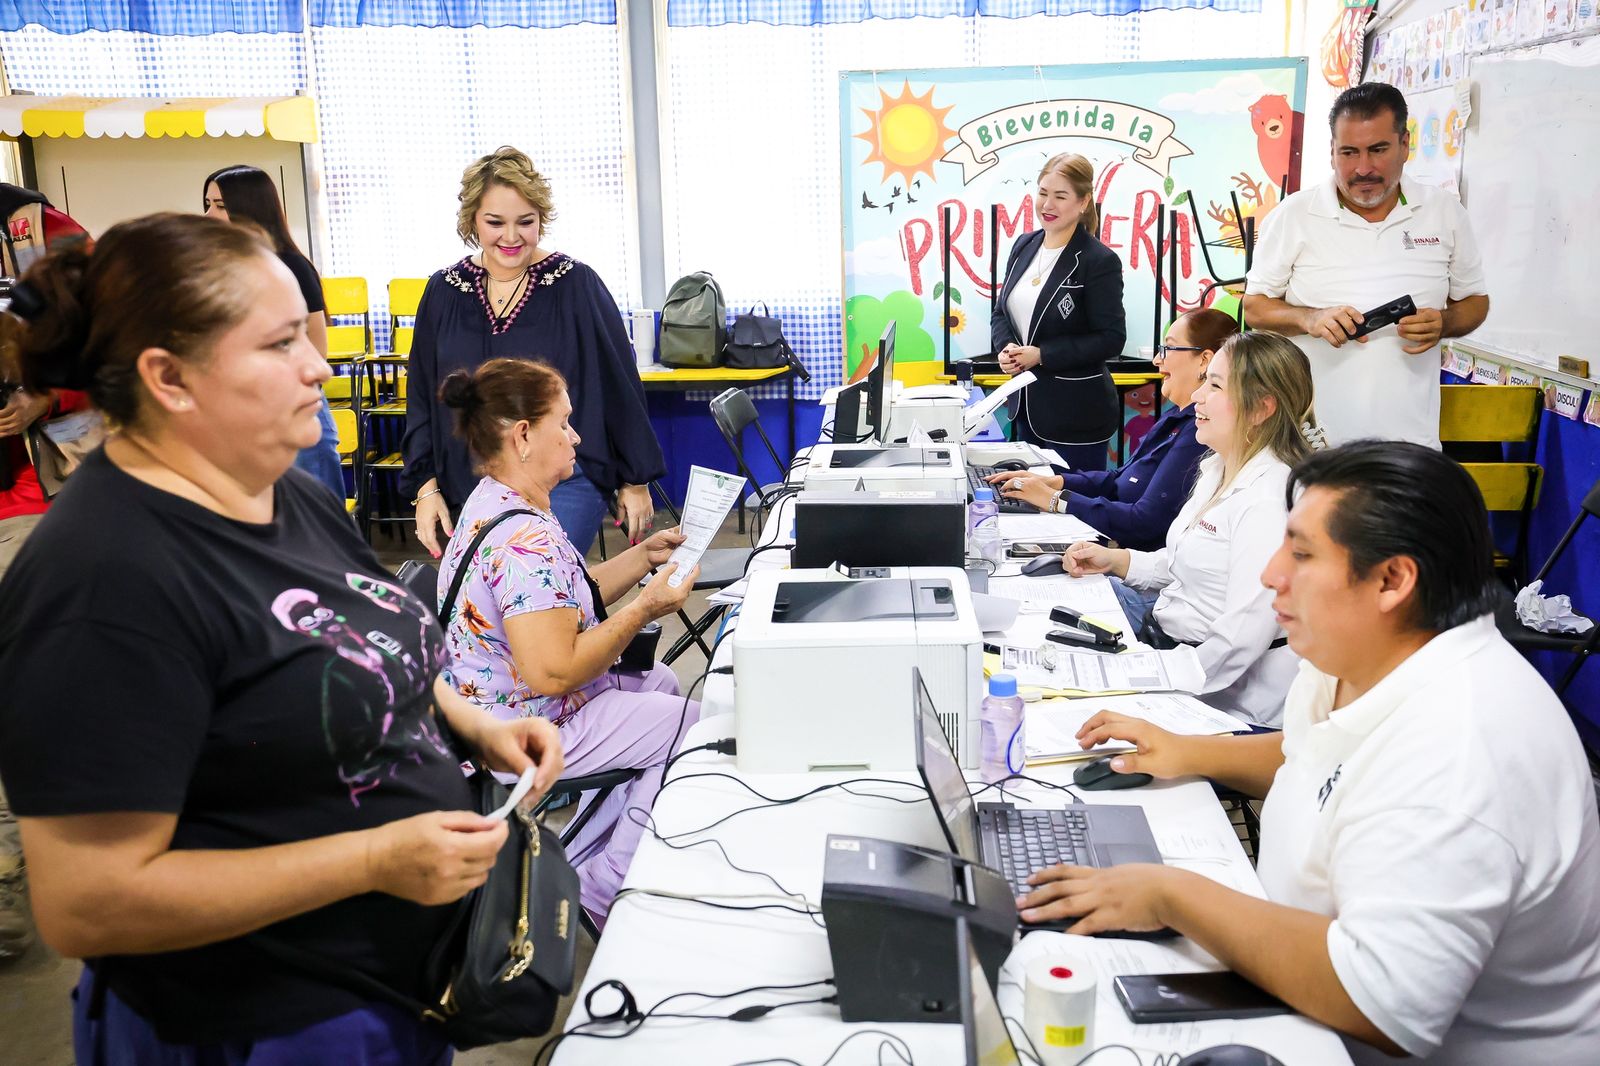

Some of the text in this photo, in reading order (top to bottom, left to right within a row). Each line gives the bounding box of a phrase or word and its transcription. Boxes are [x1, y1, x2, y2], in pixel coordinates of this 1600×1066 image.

[976, 105, 1153, 147] Bievenida la
[899, 160, 1215, 313] PRIMERA
[1510, 376, 1532, 386] PERD
[1557, 392, 1579, 408] DISCUL
